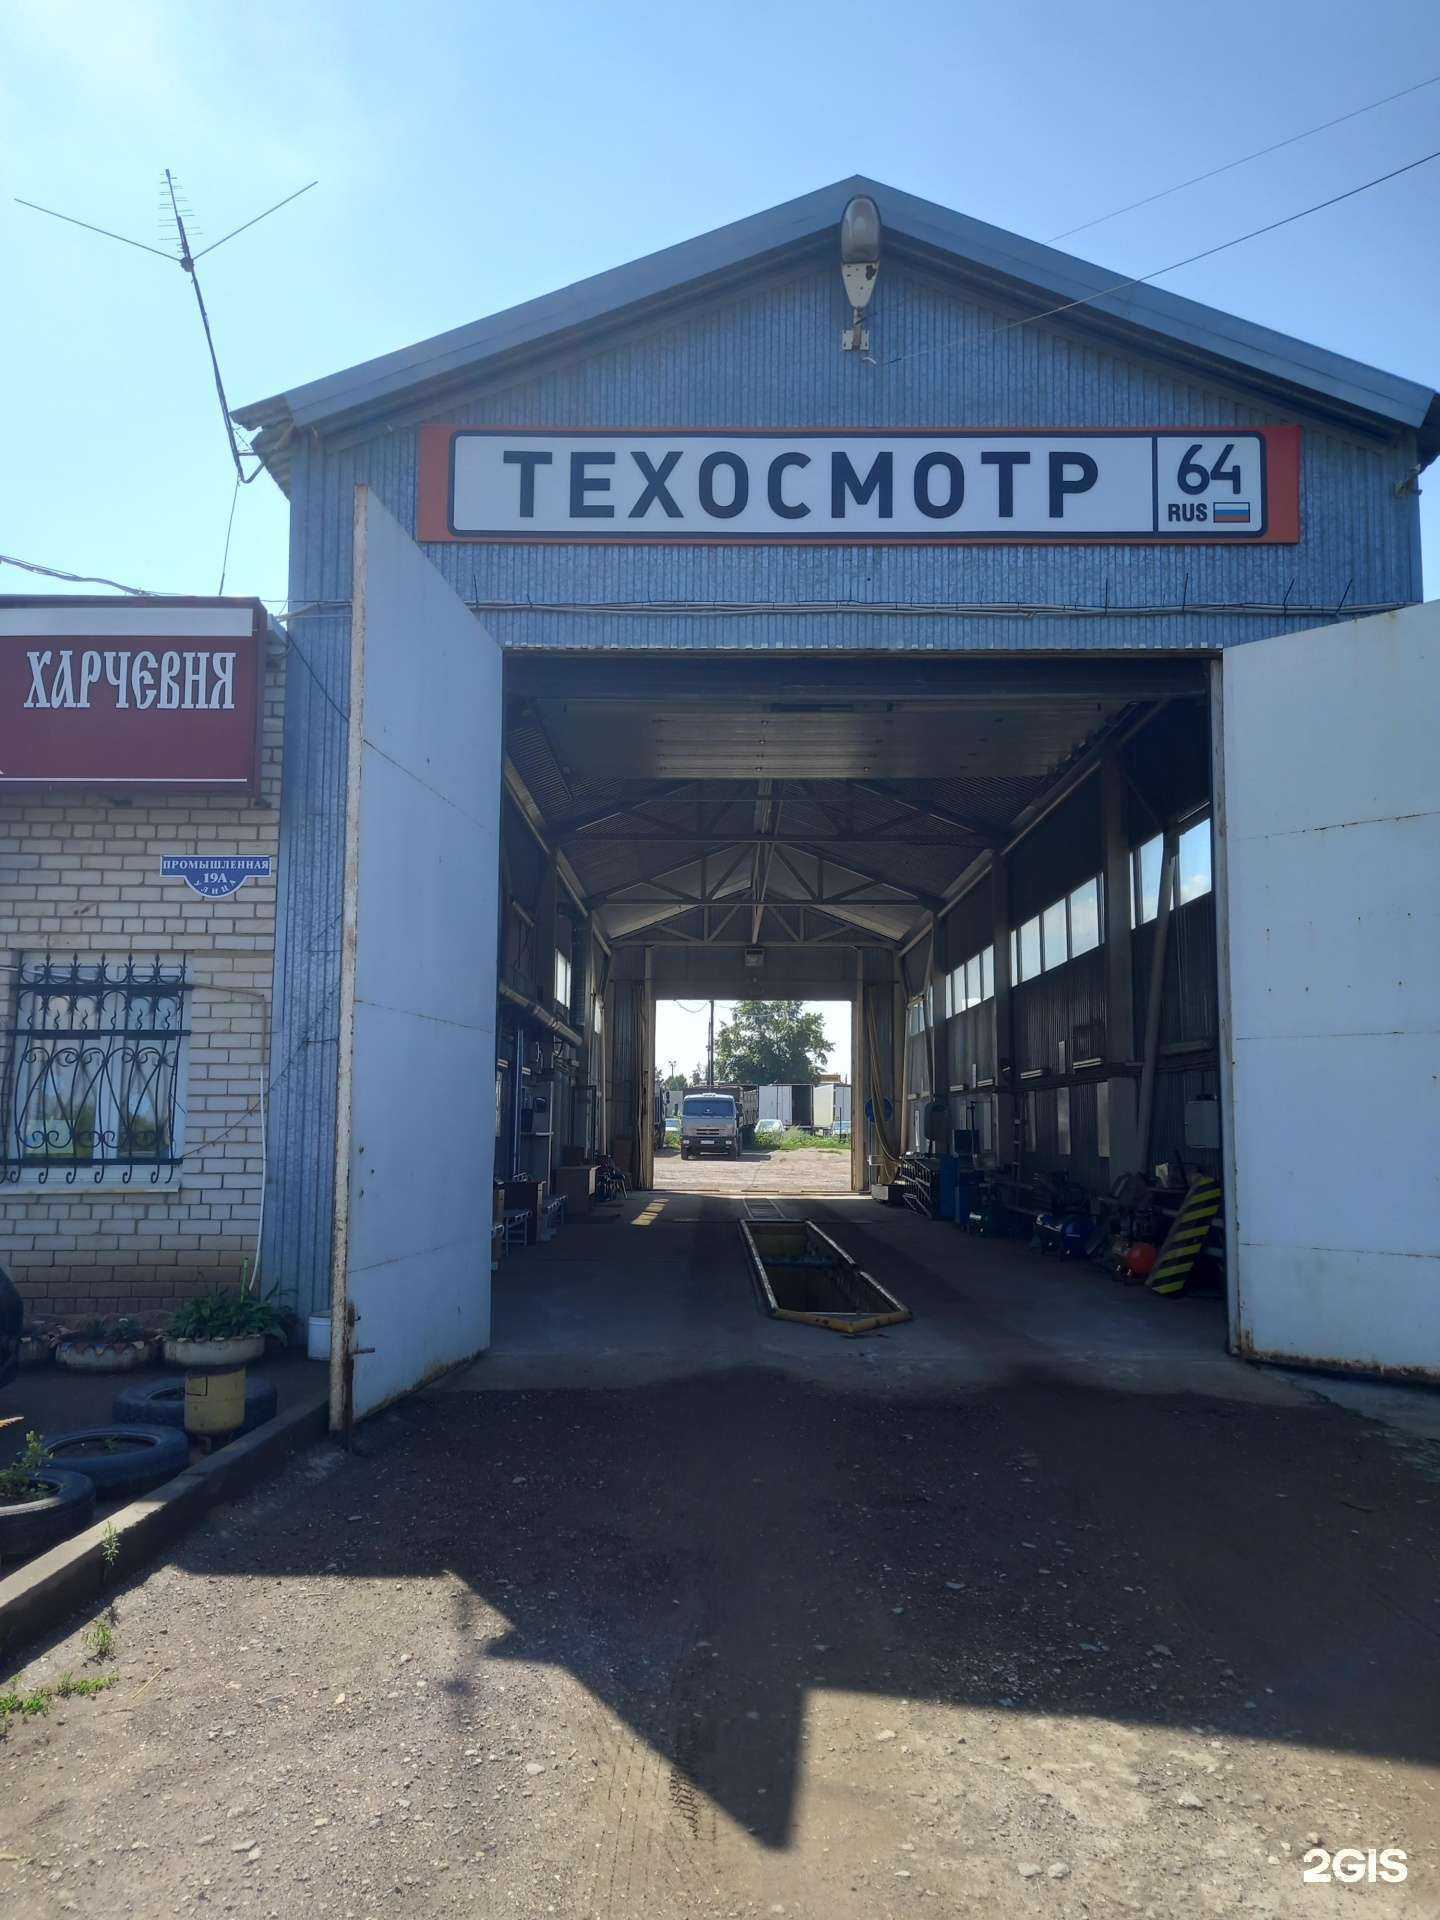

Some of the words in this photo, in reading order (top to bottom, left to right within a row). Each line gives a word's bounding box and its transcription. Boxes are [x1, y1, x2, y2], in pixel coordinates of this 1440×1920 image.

[1177, 443, 1241, 496] 64
[502, 450, 1100, 520] ТЕХОСМОТР
[1167, 502, 1208, 522] RUS
[23, 650, 237, 711] ХАРЧЕВНЯ
[163, 860, 269, 870] ПРОМЫШЛЕННАЯ
[193, 879, 236, 895] УЛИЦА
[203, 873, 228, 884] 19А
